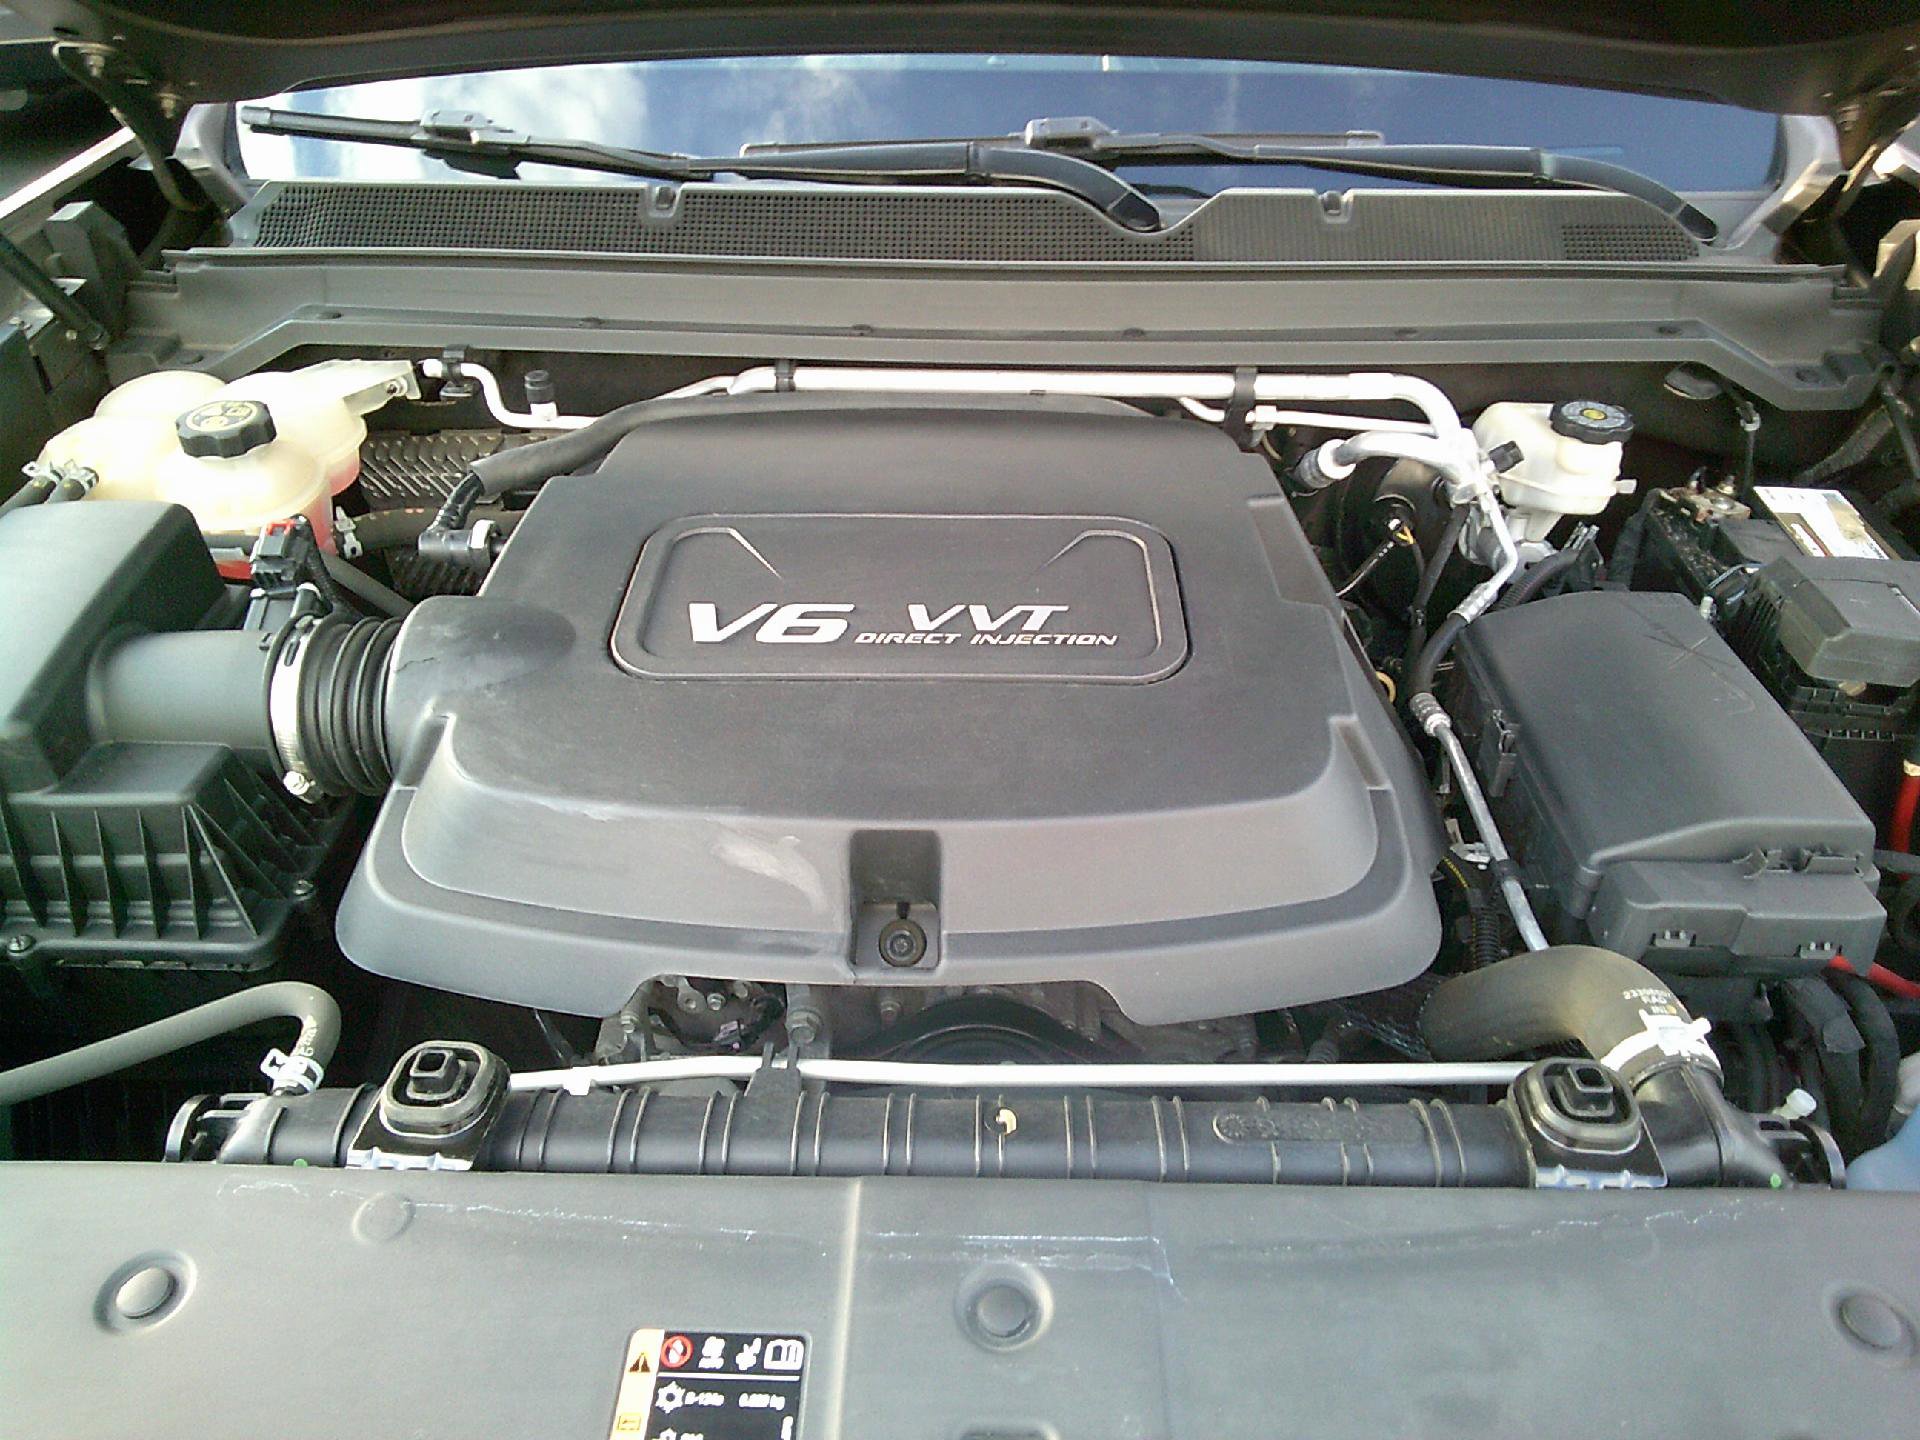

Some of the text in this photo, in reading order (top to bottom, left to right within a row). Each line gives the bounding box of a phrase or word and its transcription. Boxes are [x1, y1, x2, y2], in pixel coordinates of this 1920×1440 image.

[688, 602, 1070, 643] V6 VVT
[854, 632, 1118, 646] DIRECT INJECTION
